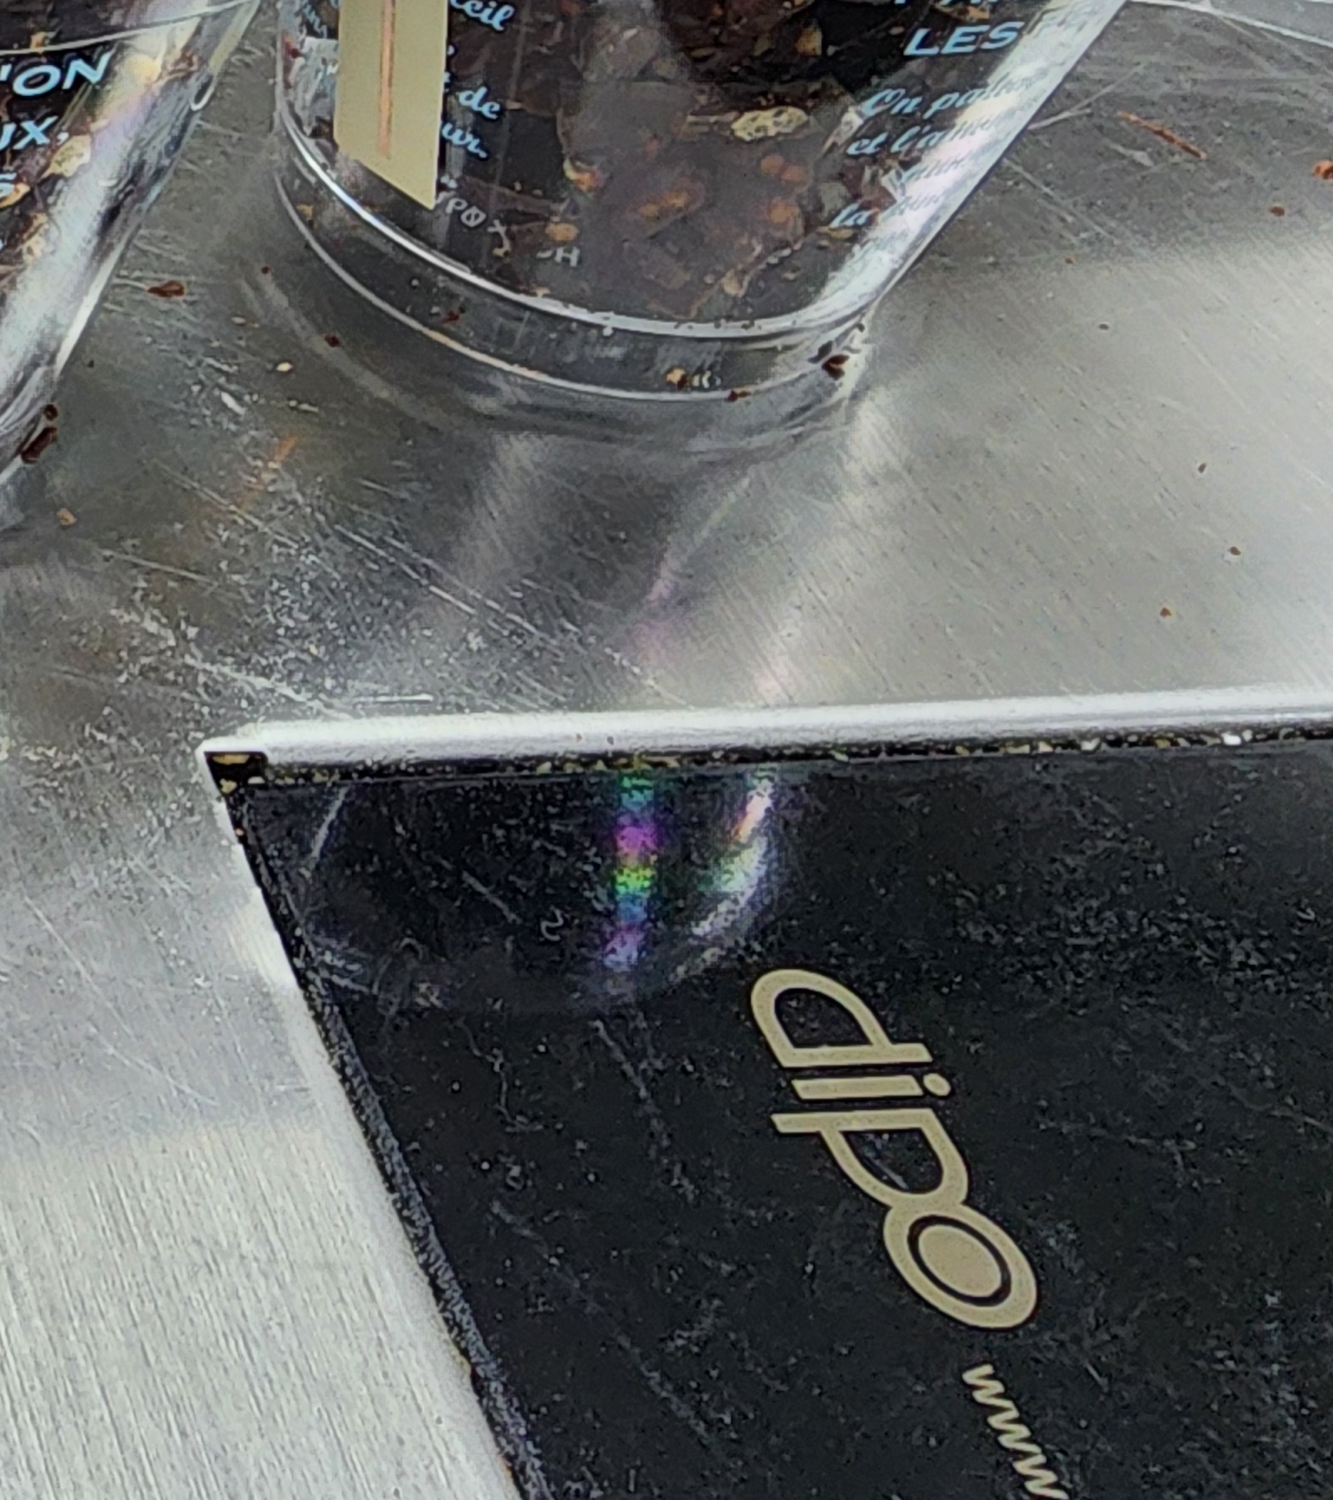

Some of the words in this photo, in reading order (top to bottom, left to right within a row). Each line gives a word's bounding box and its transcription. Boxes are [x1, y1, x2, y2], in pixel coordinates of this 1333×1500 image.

[904, 21, 1025, 56] LES
[457, 86, 501, 119] de
[846, 131, 889, 155] et
